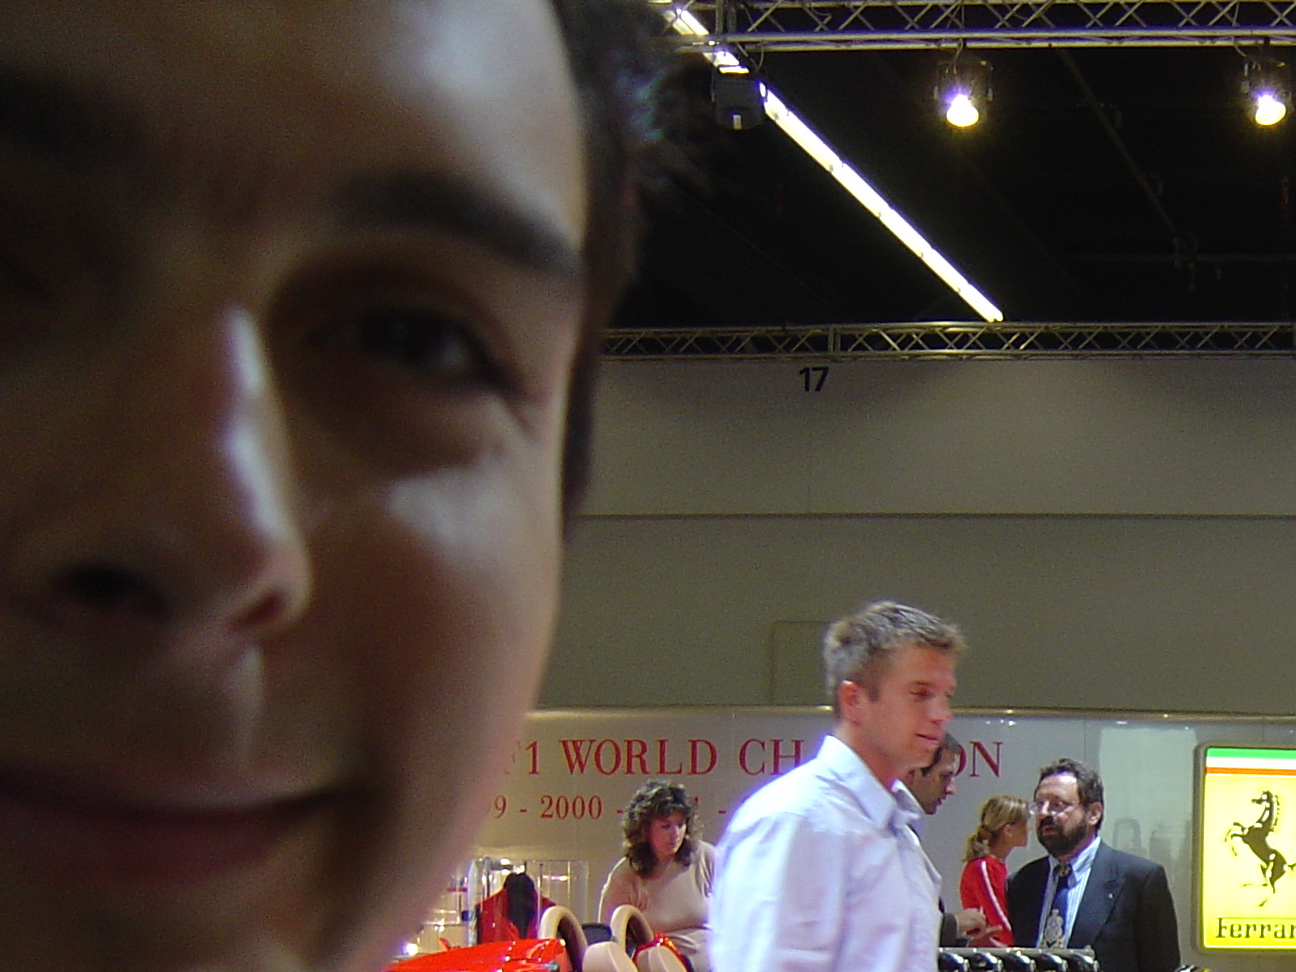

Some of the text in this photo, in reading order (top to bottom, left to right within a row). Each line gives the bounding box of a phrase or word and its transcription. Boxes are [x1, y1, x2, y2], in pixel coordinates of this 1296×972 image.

[799, 366, 829, 392] 17
[559, 739, 718, 776] WORLD
[540, 795, 602, 820] 2000
